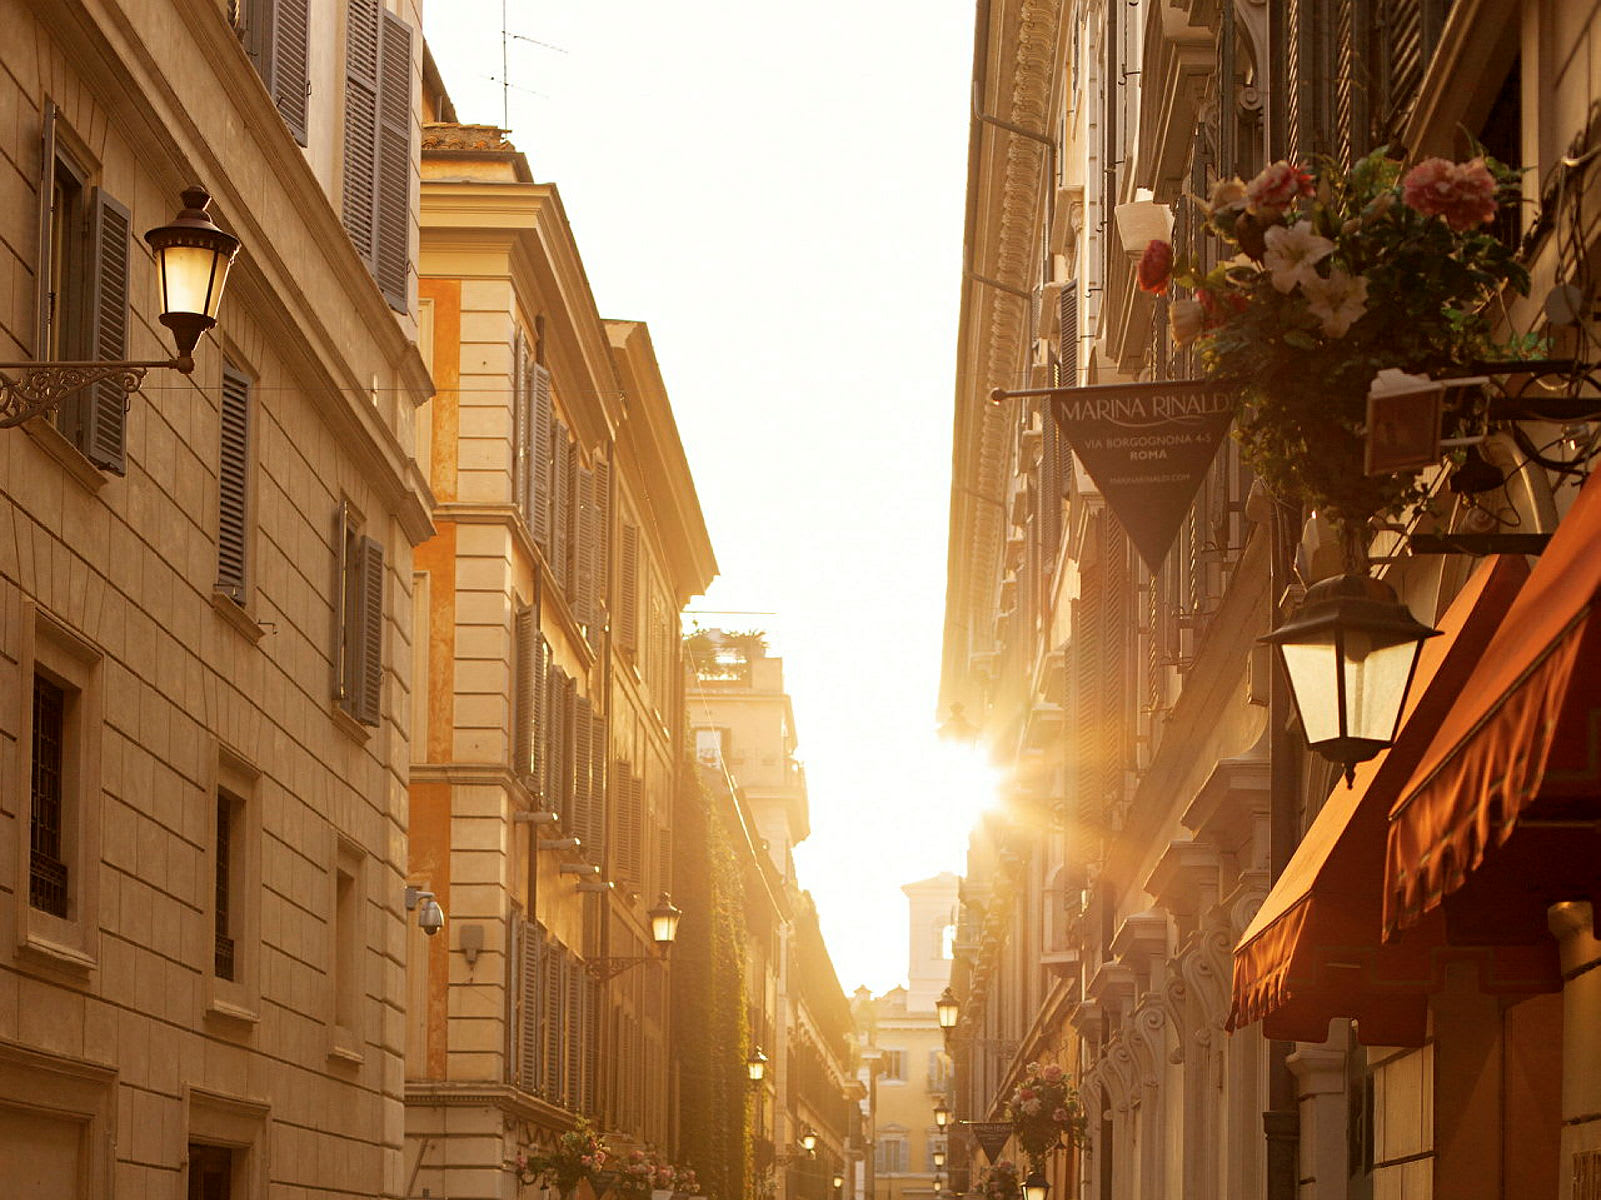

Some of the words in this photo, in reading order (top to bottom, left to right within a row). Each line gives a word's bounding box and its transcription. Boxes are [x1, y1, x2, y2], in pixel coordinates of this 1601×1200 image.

[1061, 397, 1146, 426] MARINA
[1084, 439, 1102, 449] VIA
[1106, 434, 1193, 449] BORGOGNONA
[1129, 450, 1167, 461] ROMA
